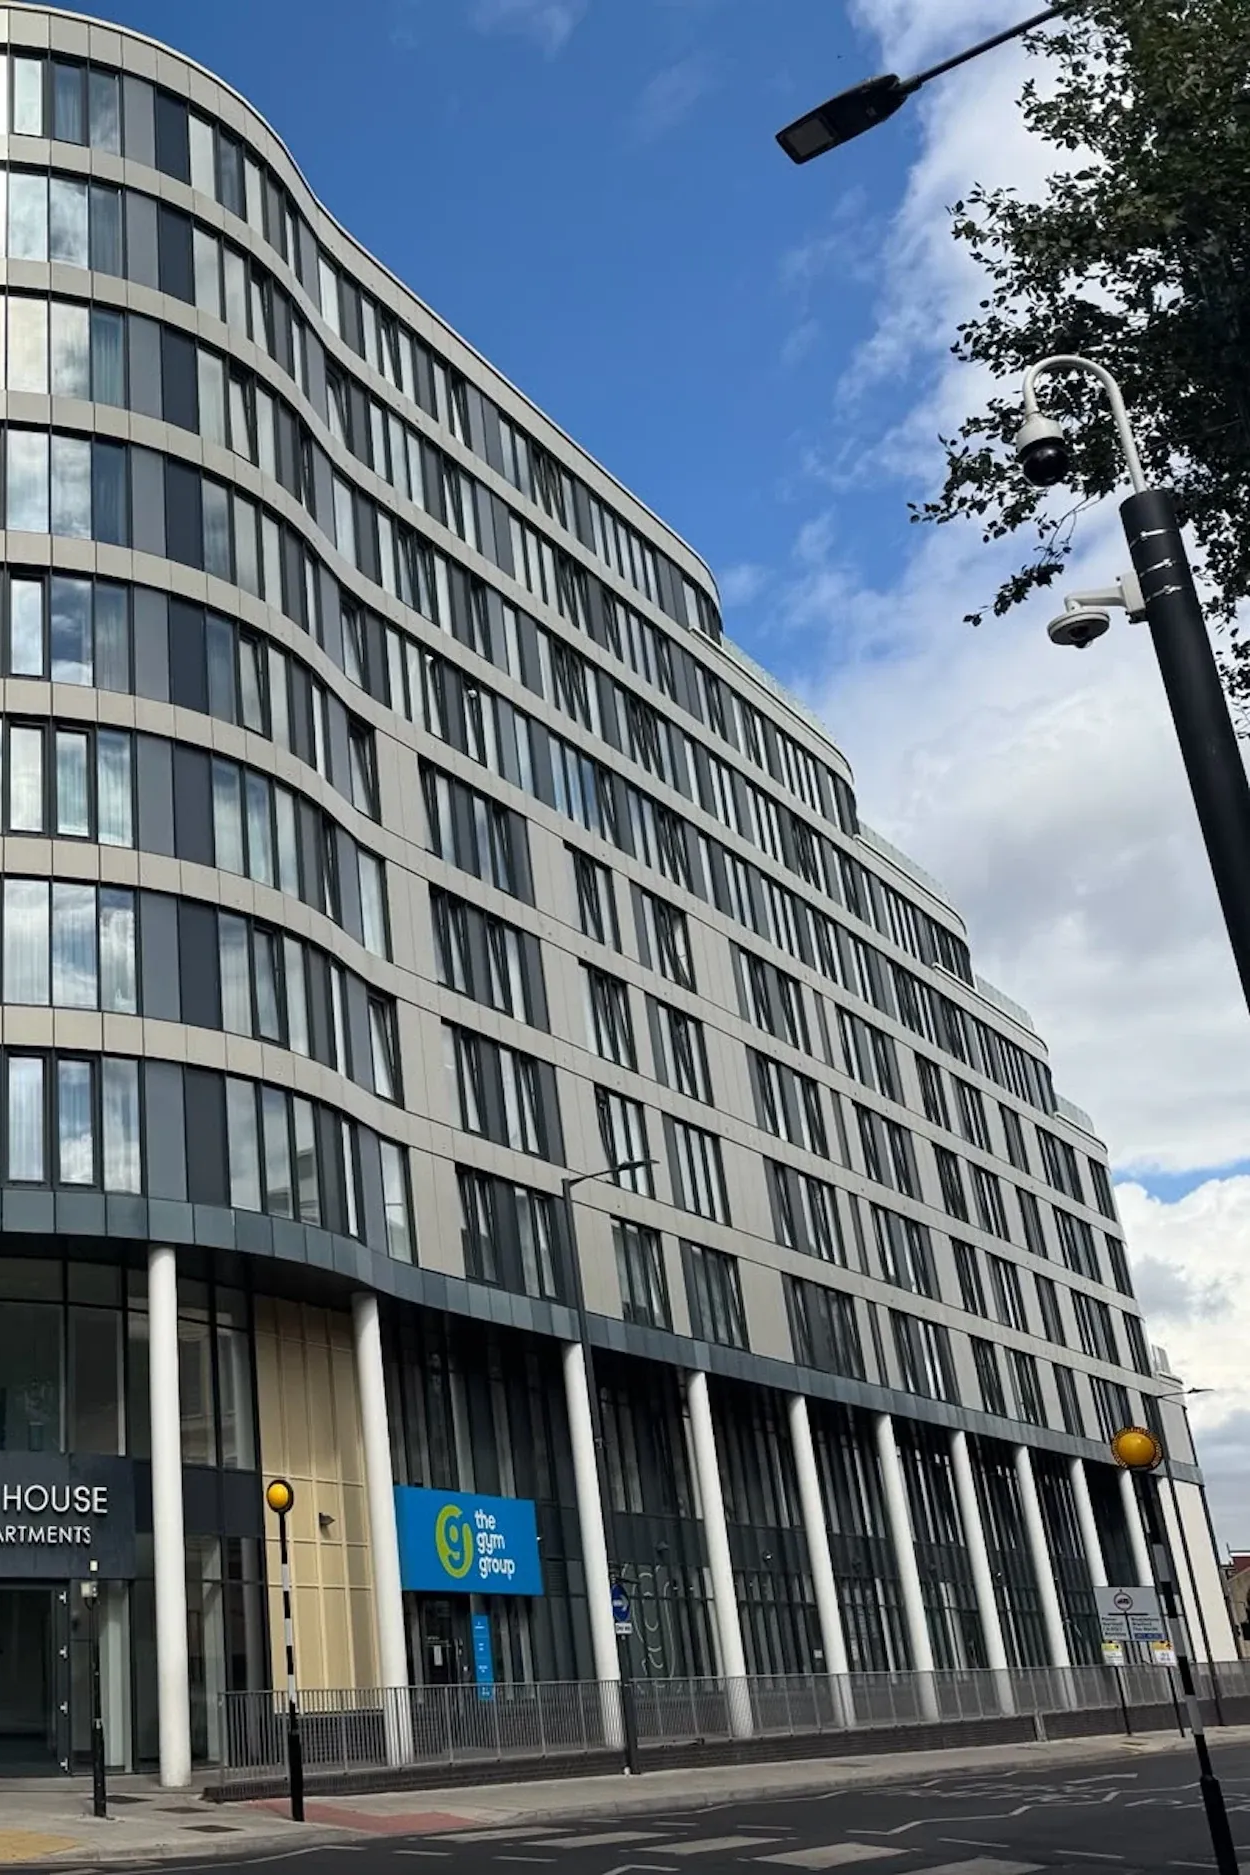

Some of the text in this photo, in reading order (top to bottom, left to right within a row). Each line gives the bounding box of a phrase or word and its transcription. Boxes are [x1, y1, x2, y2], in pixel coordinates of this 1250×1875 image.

[2, 1484, 108, 1513] HOUSE
[474, 1509, 496, 1530] the
[476, 1531, 506, 1555] gym
[478, 1556, 516, 1581] group
